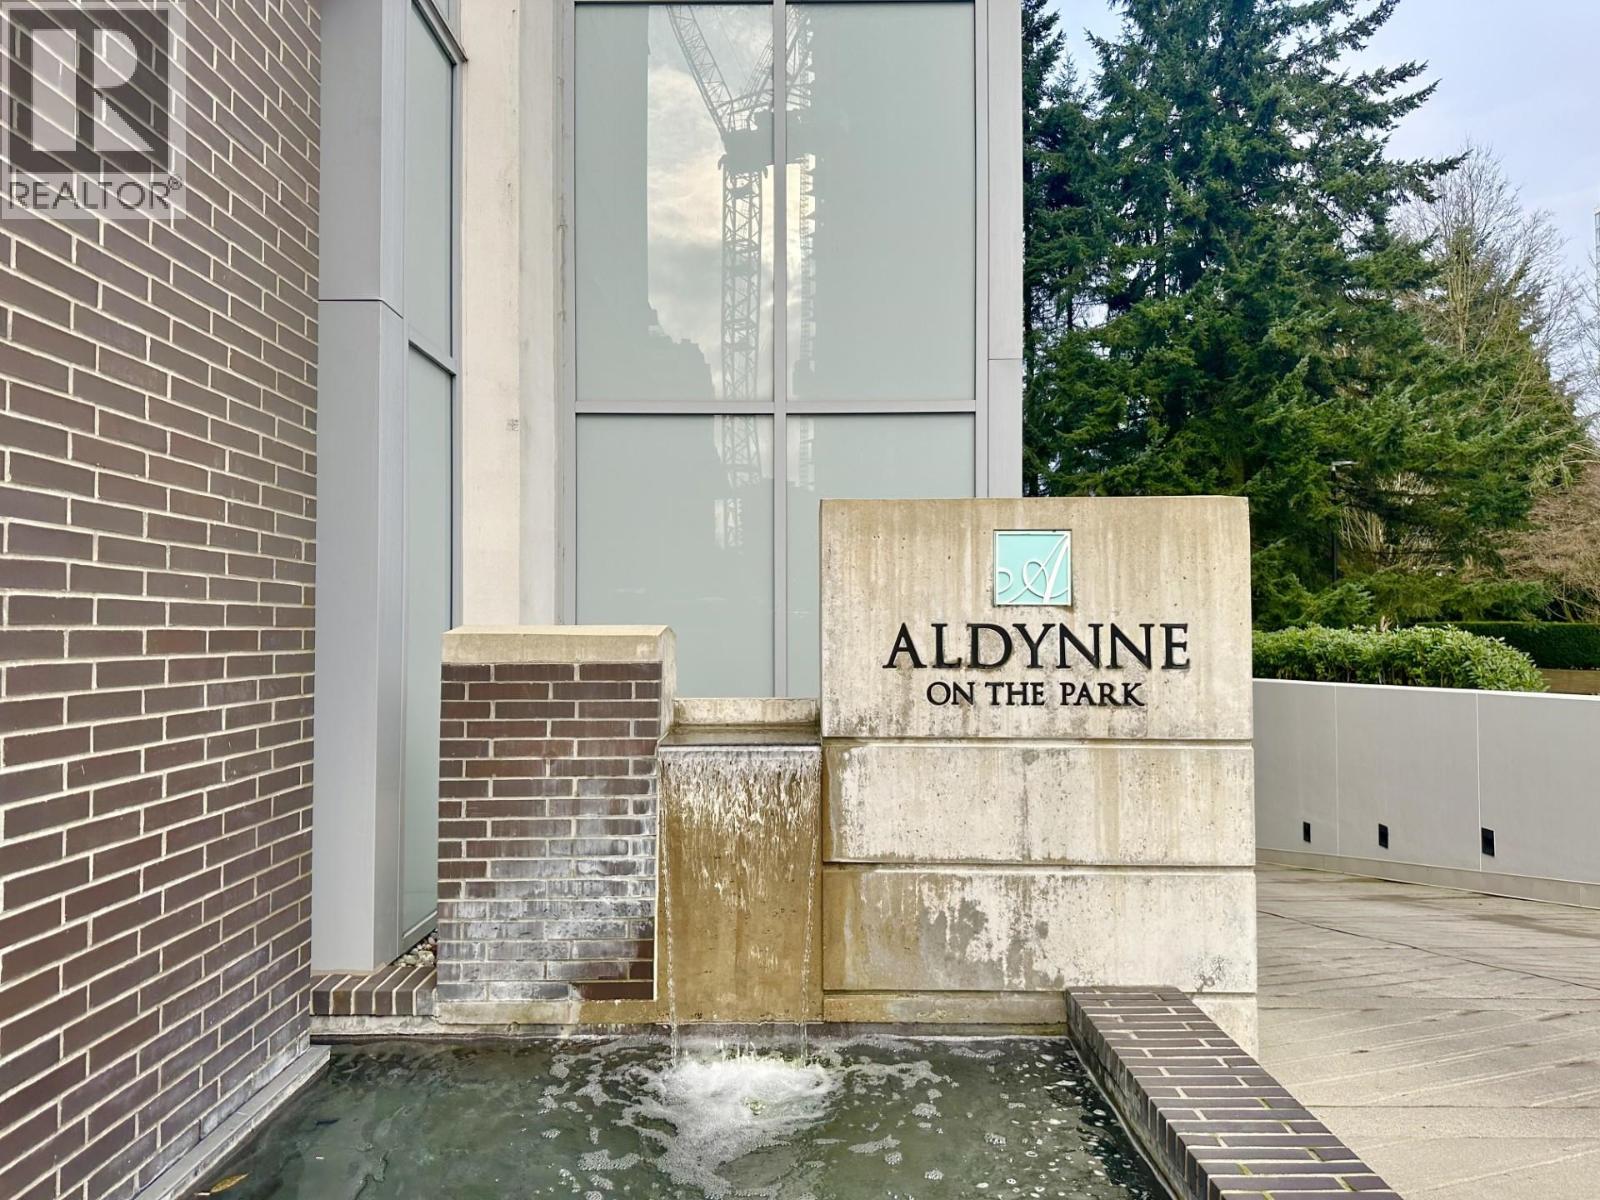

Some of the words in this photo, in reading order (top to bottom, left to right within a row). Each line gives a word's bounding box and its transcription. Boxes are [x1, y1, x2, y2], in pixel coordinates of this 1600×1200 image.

[882, 622, 1191, 670] ALDYNNE
[926, 681, 975, 706] ON
[984, 682, 1046, 706] THE
[1060, 682, 1145, 706] PARK
